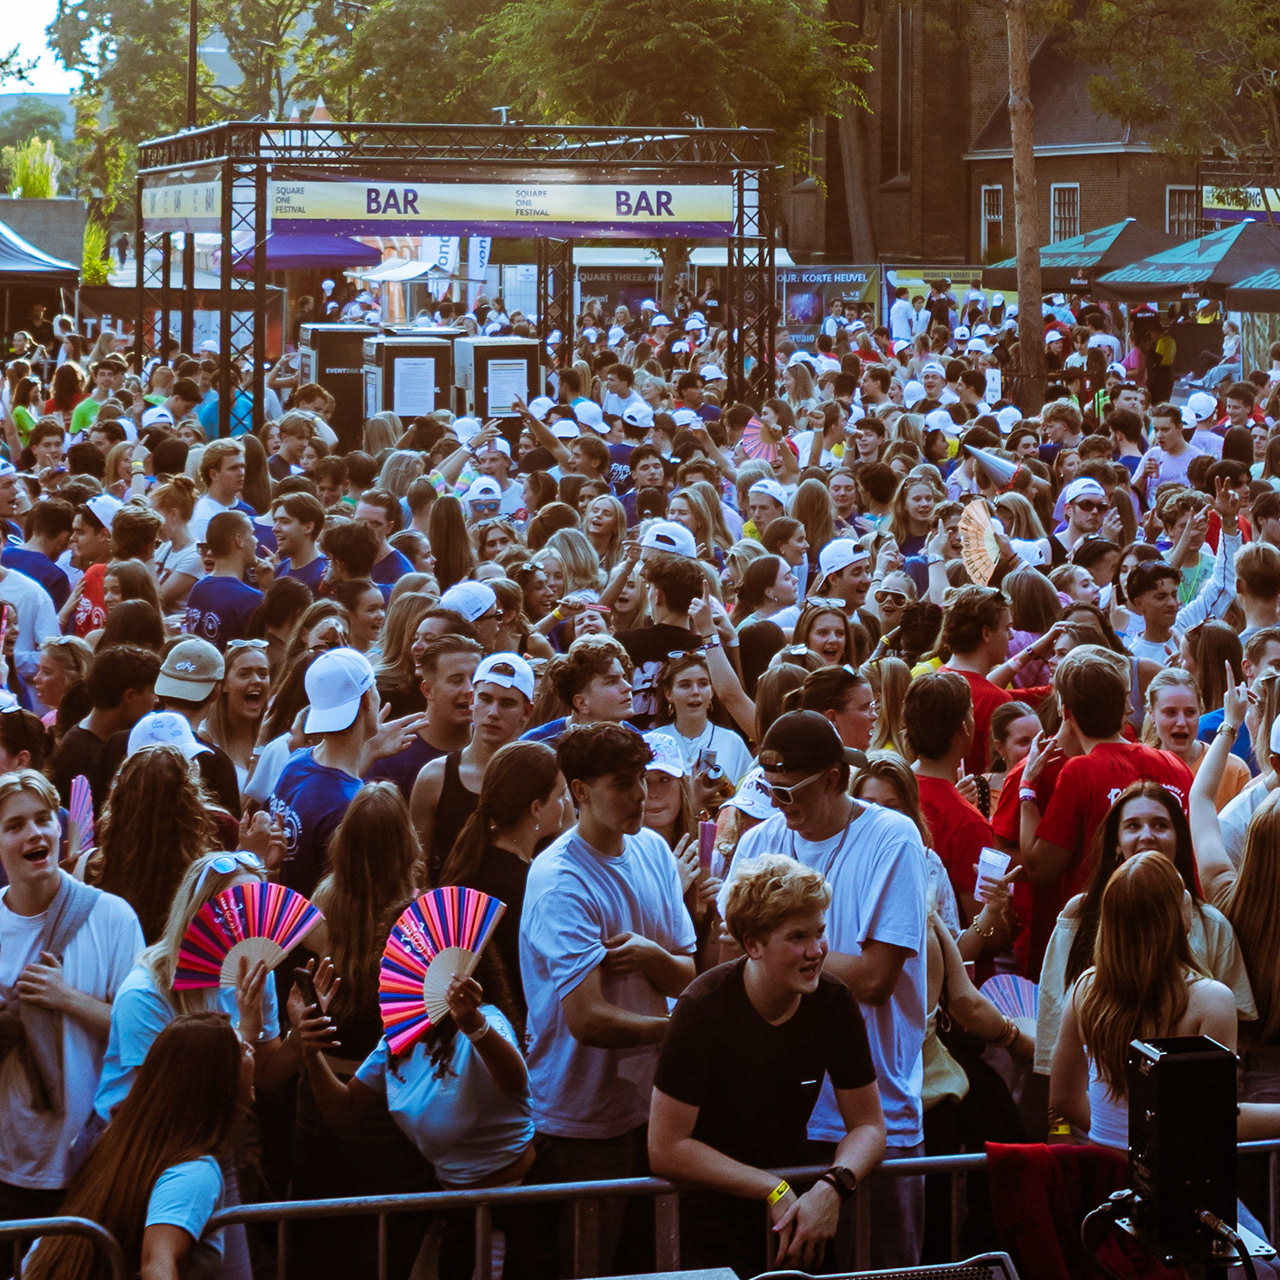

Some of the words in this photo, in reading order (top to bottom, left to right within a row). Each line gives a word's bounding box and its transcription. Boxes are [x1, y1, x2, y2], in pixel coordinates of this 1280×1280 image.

[275, 186, 305, 195] SQUARE
[275, 196, 291, 204] ONE
[366, 188, 420, 214] BAR
[515, 199, 533, 207] ONE
[615, 190, 675, 217] BAR
[515, 208, 550, 216] FESTIVAL
[573, 273, 611, 282] SQUARE
[615, 273, 646, 282] THREE:
[802, 273, 832, 282] KORTE
[834, 273, 868, 282] HEUVEL
